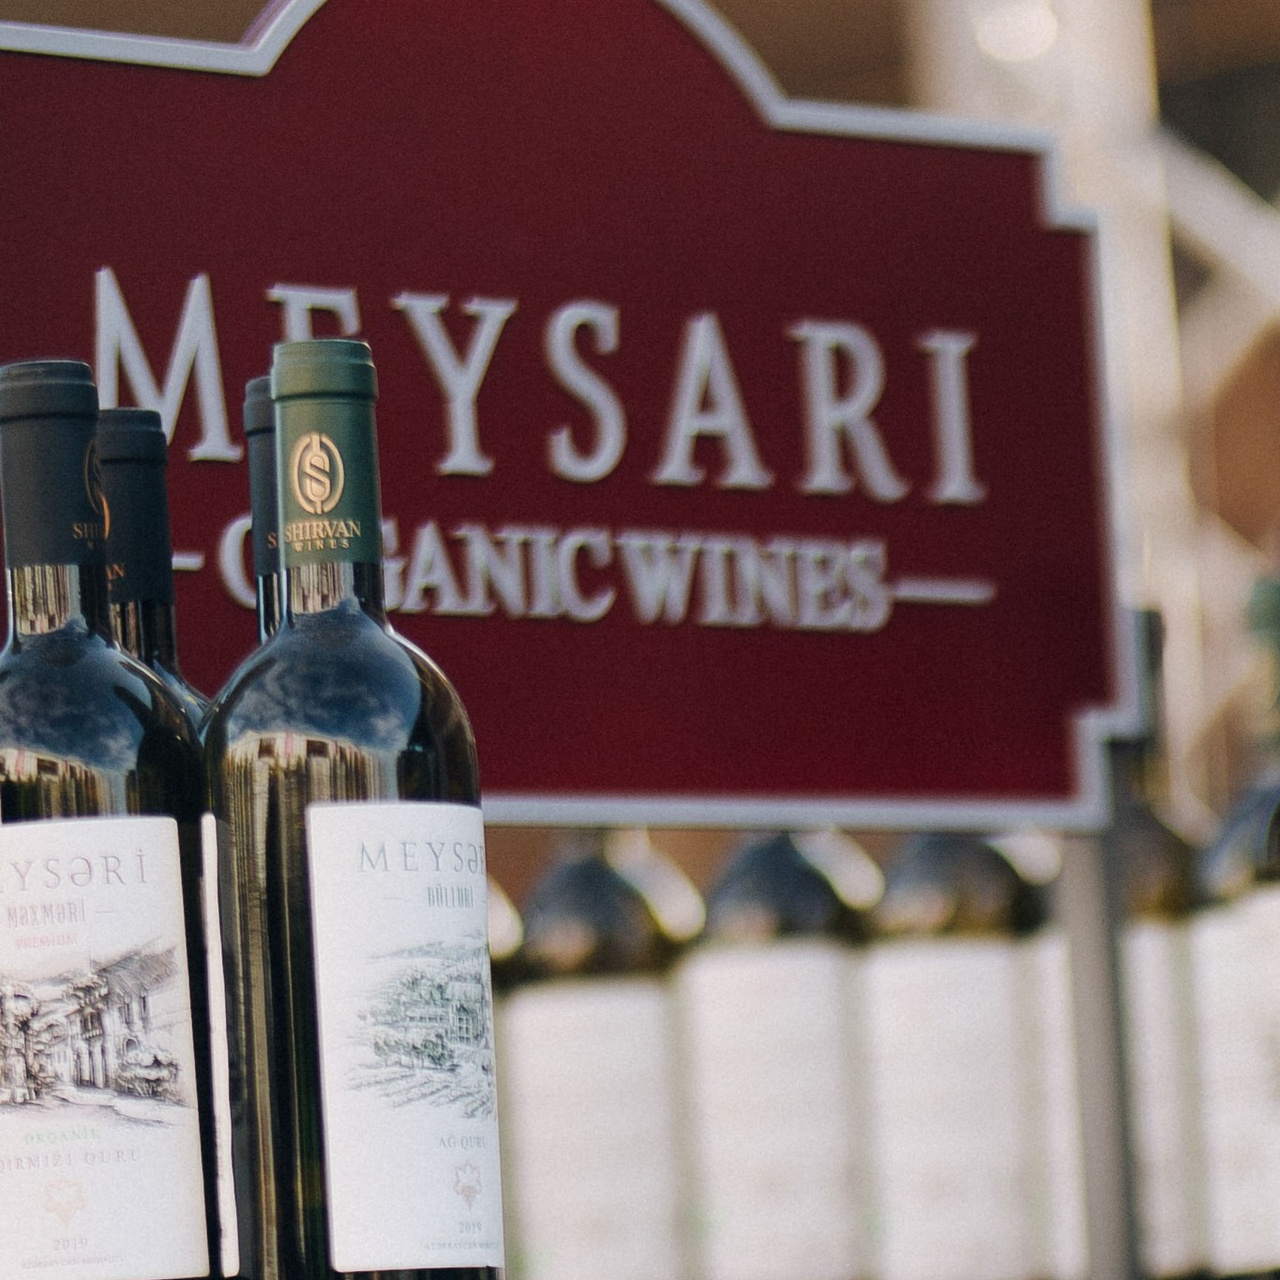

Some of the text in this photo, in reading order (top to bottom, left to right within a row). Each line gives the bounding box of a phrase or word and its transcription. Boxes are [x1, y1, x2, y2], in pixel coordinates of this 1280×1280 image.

[284, 518, 362, 543] SHIRVAN
[292, 538, 350, 553] WINES
[614, 530, 893, 635] WINES
[0, 847, 147, 892] YSƏRİ
